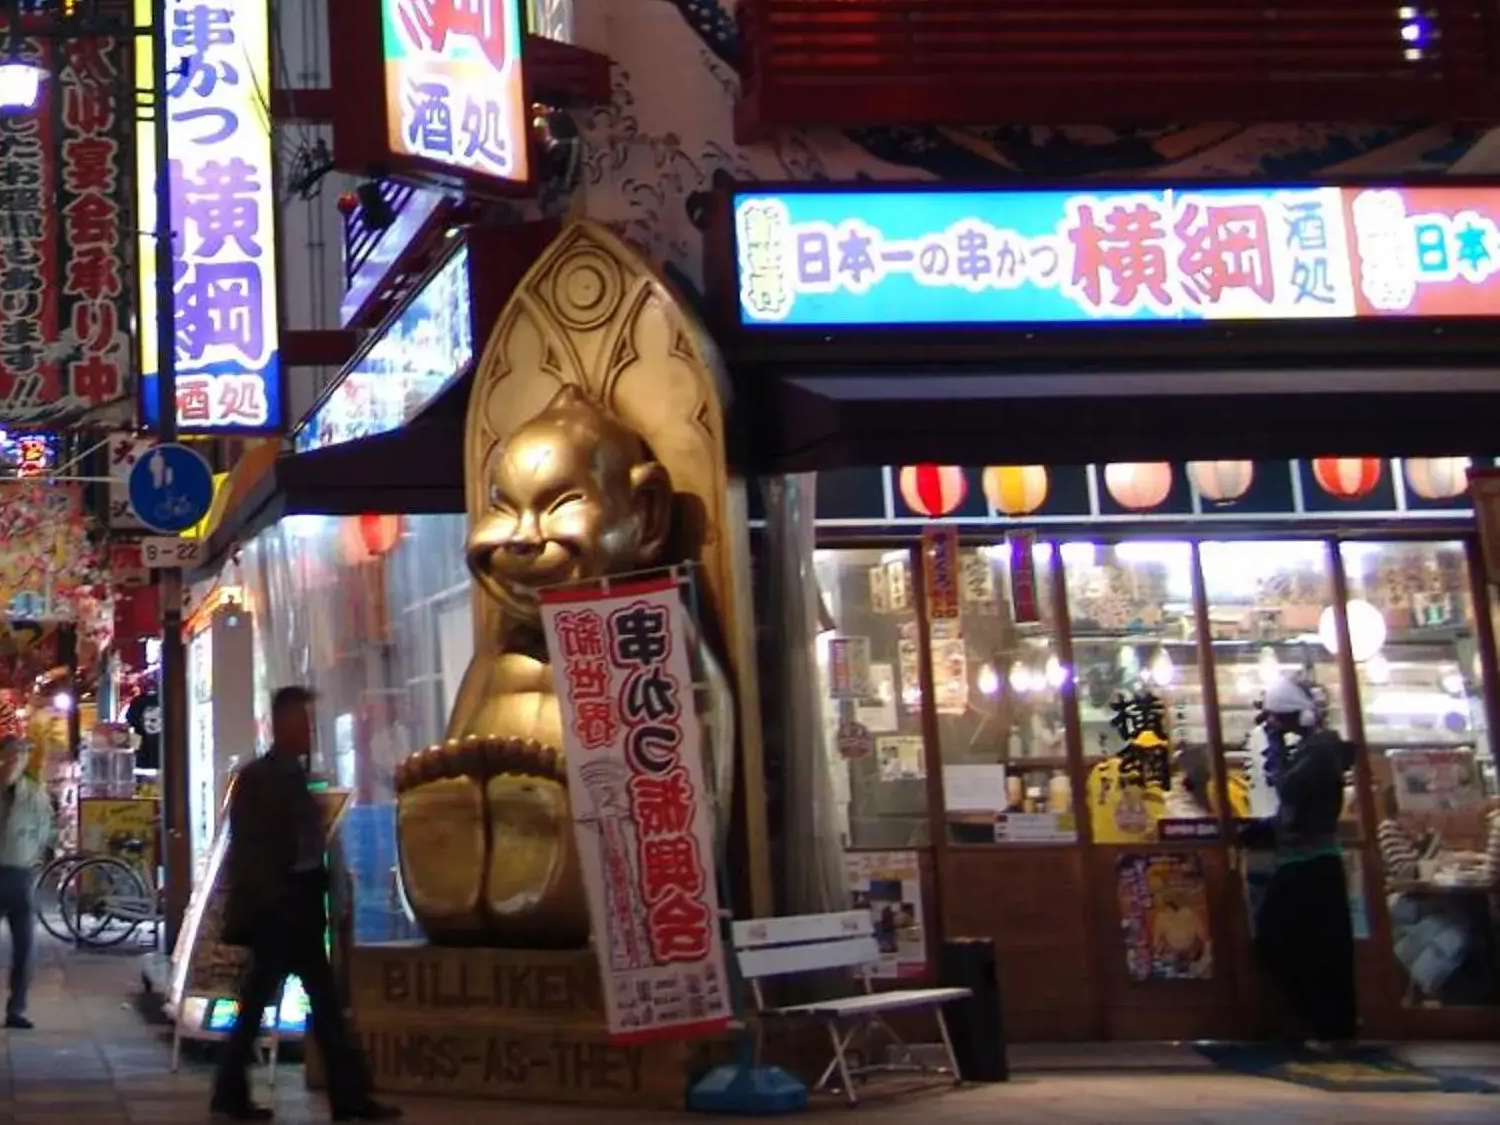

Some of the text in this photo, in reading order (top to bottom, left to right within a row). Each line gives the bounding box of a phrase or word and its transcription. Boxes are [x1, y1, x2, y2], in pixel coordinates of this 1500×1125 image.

[407, 78, 506, 167] 酒処
[168, 156, 264, 367] 横綱
[796, 229, 1060, 283] 日本一の串かつ
[1069, 202, 1277, 307] 横綱
[1286, 201, 1336, 305] 酒処
[1108, 692, 1171, 792] 横綱
